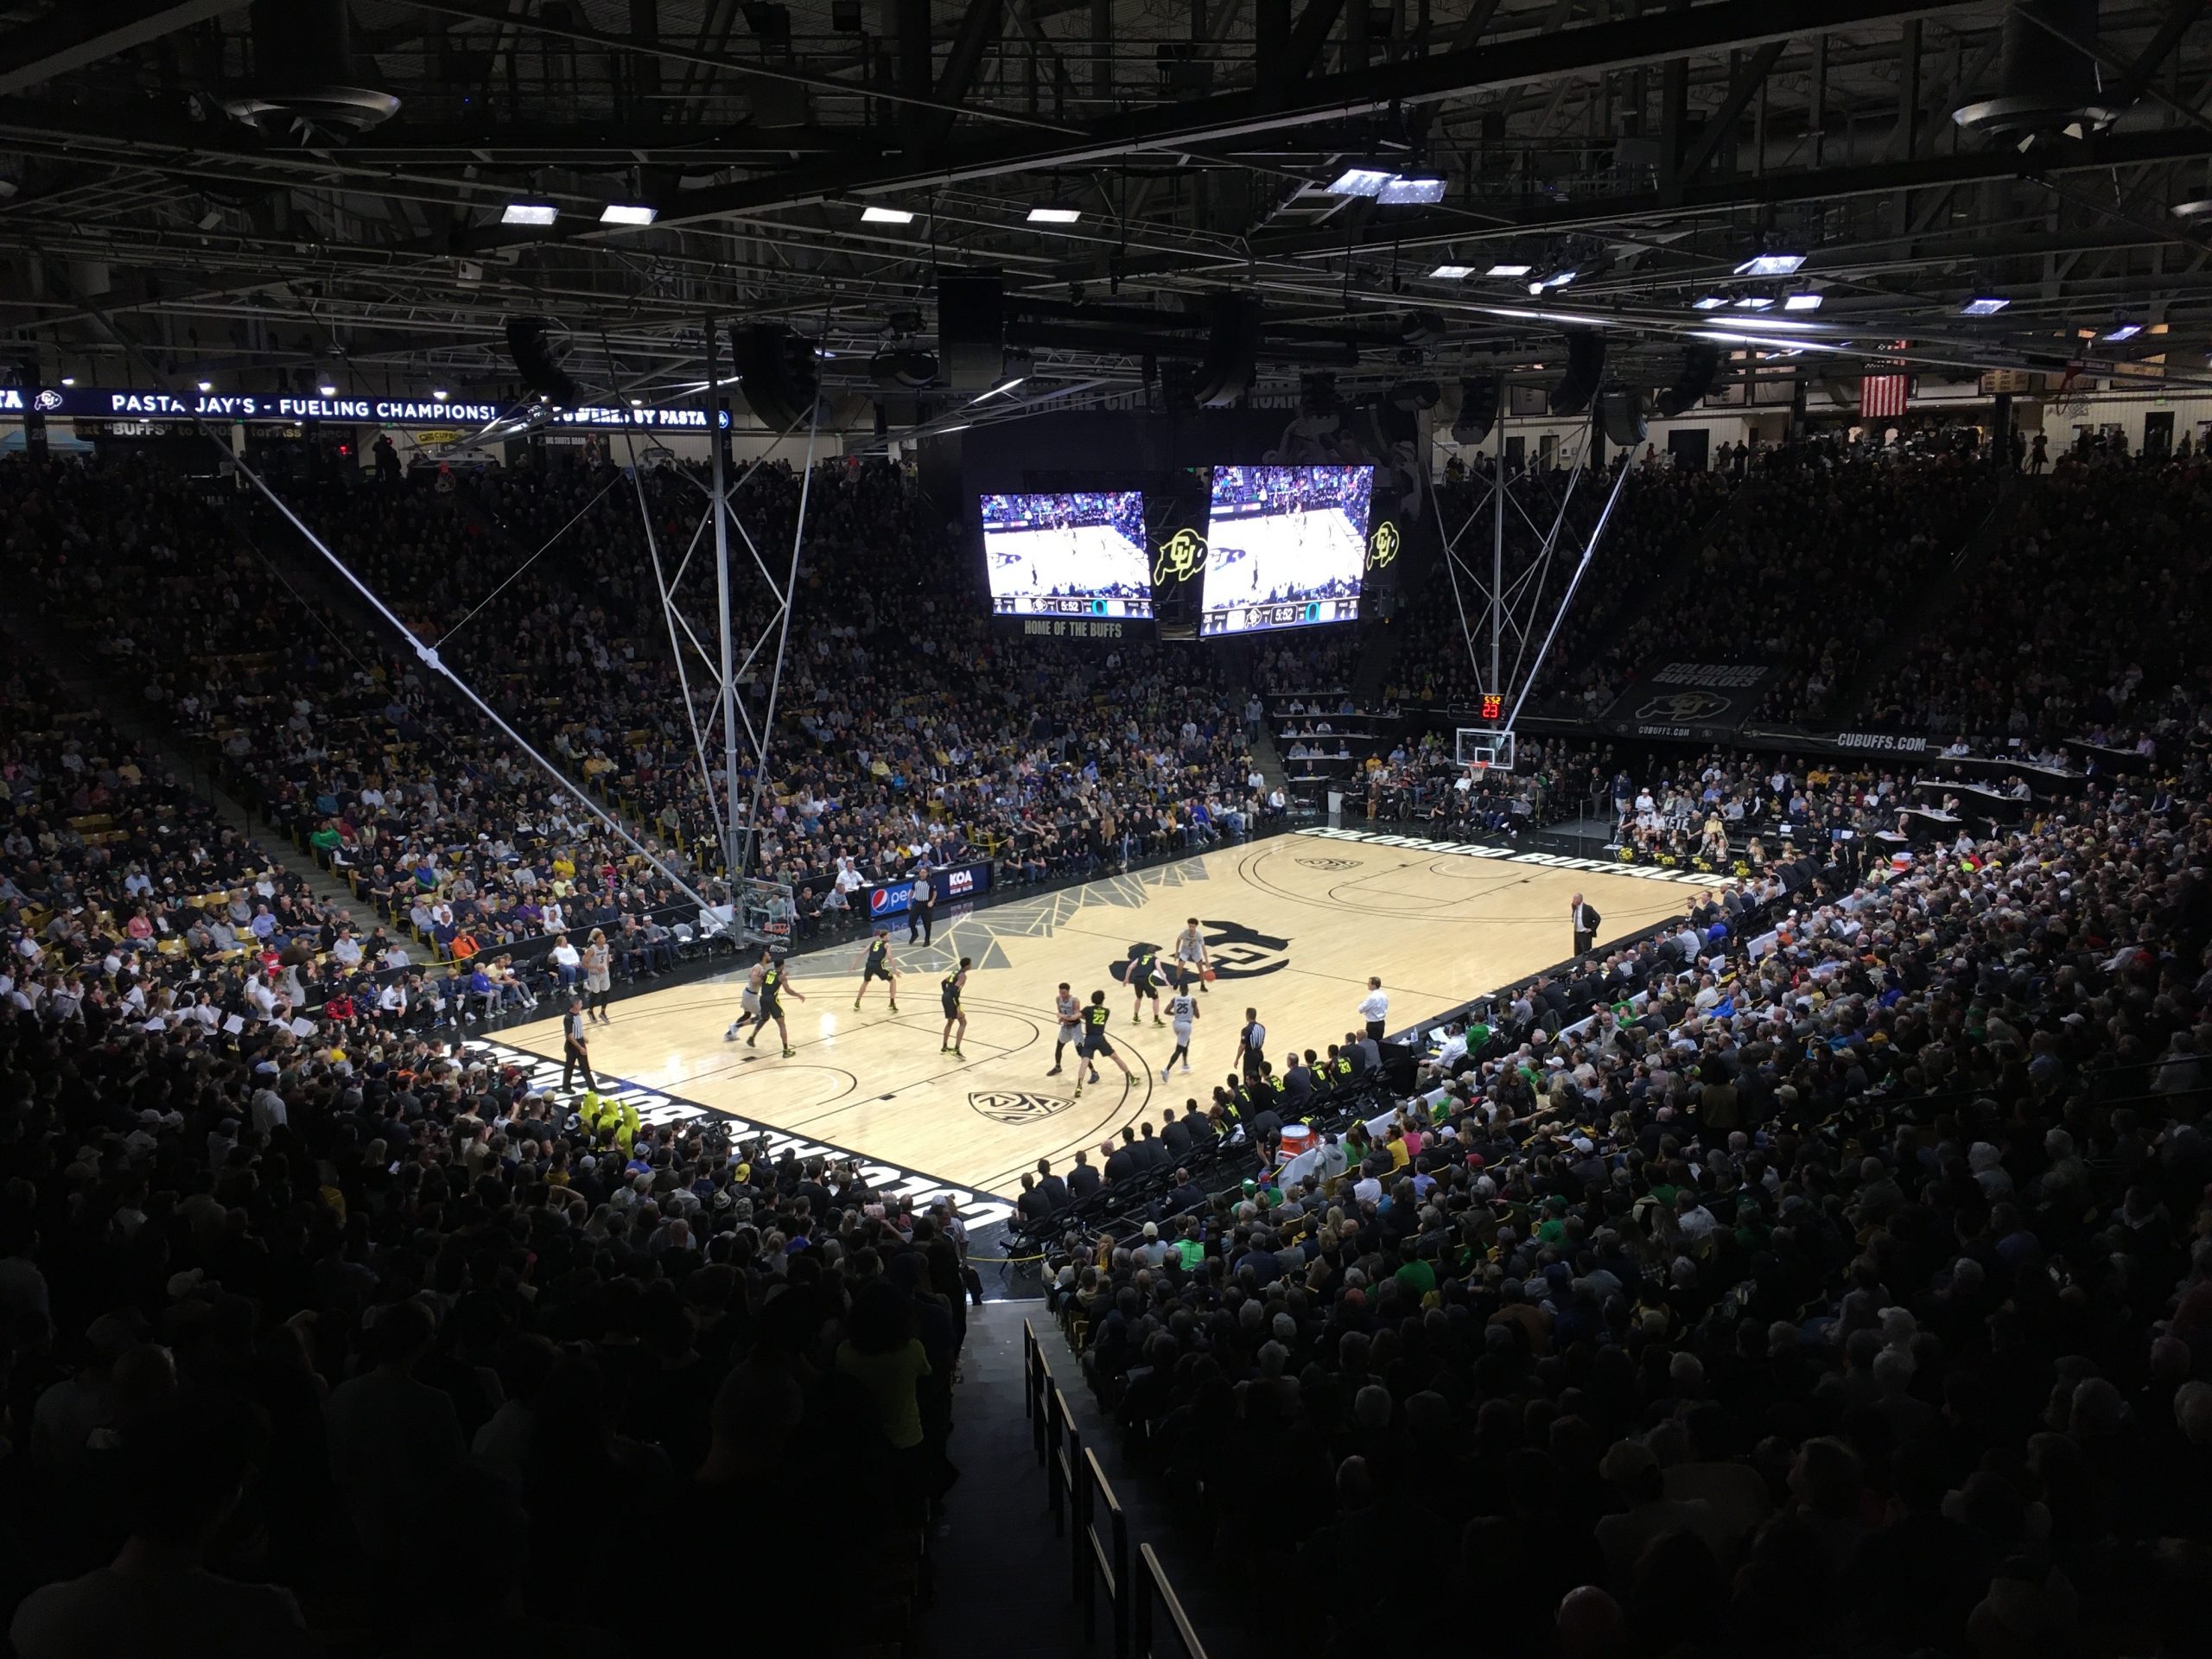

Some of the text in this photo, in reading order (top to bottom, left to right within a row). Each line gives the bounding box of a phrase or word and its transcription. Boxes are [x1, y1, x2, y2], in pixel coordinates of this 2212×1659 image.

[111, 394, 186, 412] PASTA
[194, 396, 256, 414] JAY'S
[279, 398, 369, 416] FUELING
[376, 401, 496, 420] CHAMPIONS!
[659, 410, 707, 425] PASTA
[1060, 601, 1079, 612] 5:52
[1274, 607, 1294, 621] 5:52
[1024, 620, 1122, 638] HOME OF THE BUFFS
[1662, 662, 1770, 677] COLORADO
[1651, 672, 1759, 687] BUFFALOES
[1482, 704, 1498, 718] 23
[1638, 726, 1690, 737] CUBUFFS.COM
[1837, 733, 1927, 752] CUBUFFS.COM
[1294, 826, 1516, 857] COLORADO
[949, 869, 973, 887] KOA
[1176, 1002, 1189, 1014] 25
[1092, 1014, 1105, 1025] 22
